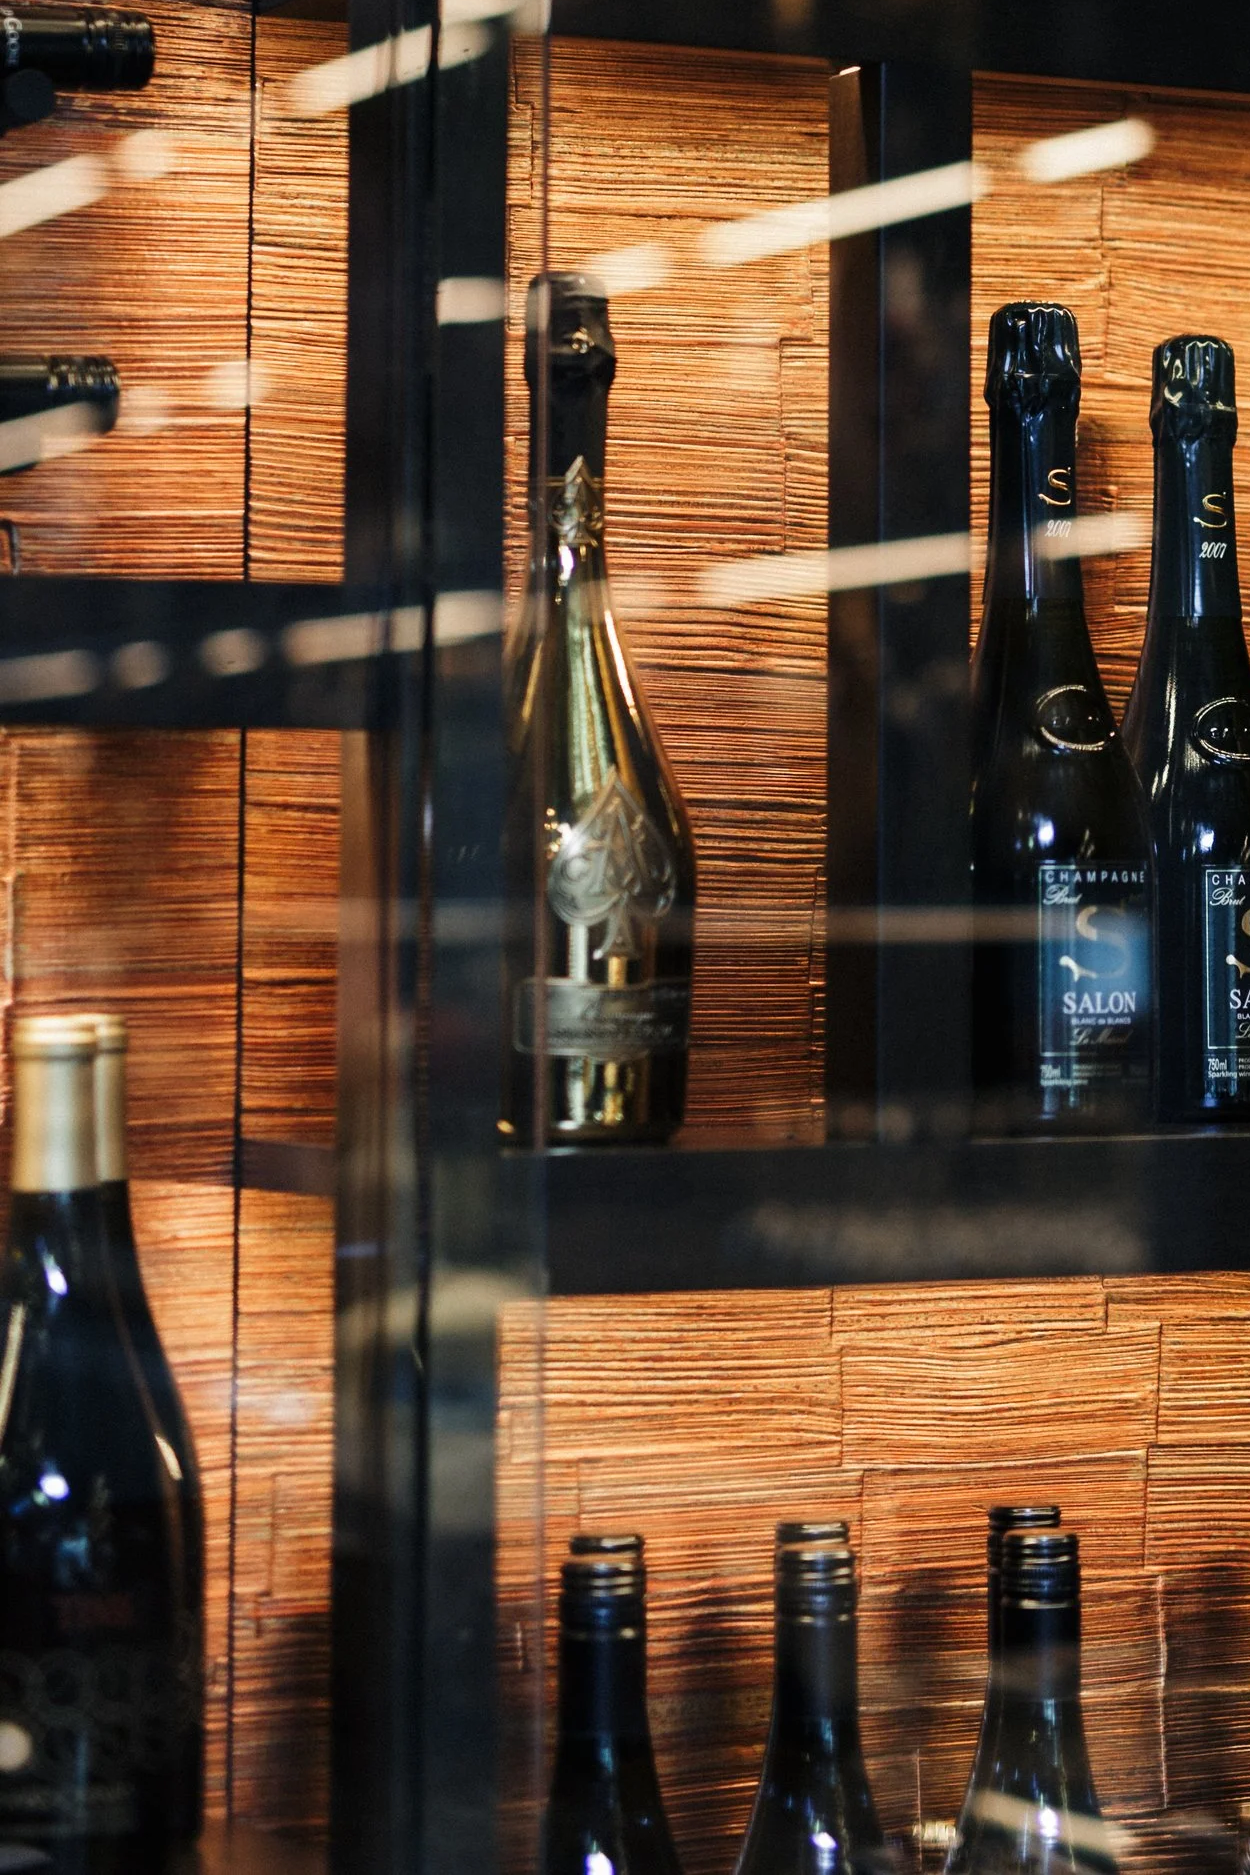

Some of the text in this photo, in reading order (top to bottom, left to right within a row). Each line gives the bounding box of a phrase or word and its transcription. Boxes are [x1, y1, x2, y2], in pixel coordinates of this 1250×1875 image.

[1037, 467, 1071, 506] S
[1193, 491, 1227, 528] S
[1199, 541, 1227, 558] 2007
[1045, 870, 1145, 883] CHAMPAGNE
[1043, 884, 1082, 905] Brut
[1209, 887, 1246, 906] Brut
[1062, 991, 1137, 1015] SALON
[1208, 1057, 1228, 1071] 750ml
[1208, 1070, 1238, 1079] Sparkling
